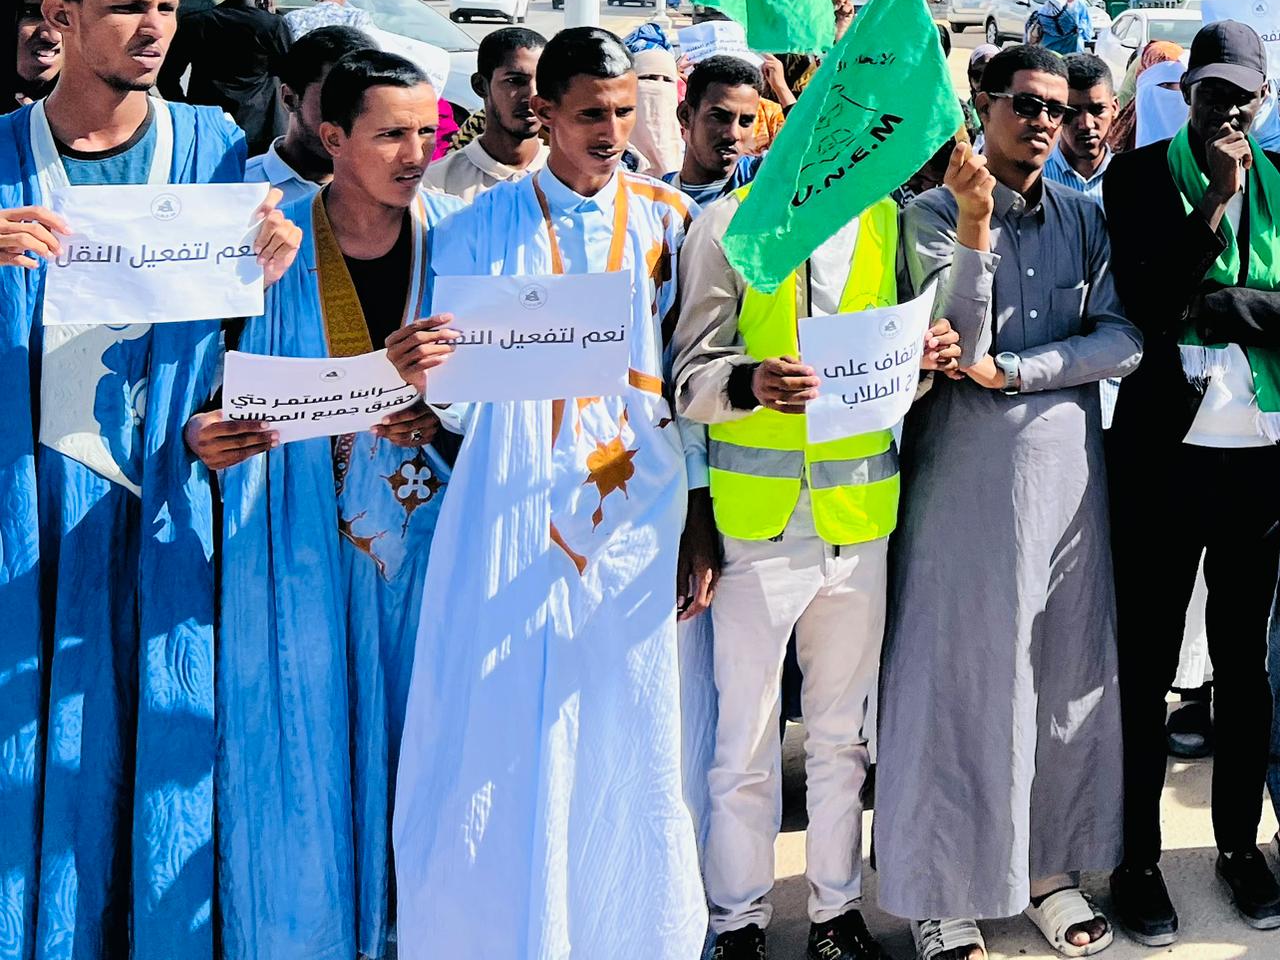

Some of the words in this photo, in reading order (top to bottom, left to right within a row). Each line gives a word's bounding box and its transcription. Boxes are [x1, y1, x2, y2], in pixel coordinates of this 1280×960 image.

[55, 244, 121, 268] النقل
[129, 242, 209, 269] لتفعيل
[216, 242, 259, 264] عم
[435, 329, 493, 345] الن
[500, 327, 575, 350] لتفعيل
[582, 325, 625, 348] نعم
[823, 359, 869, 378] على
[272, 394, 343, 408] مستمر
[350, 383, 410, 400] رابنا
[842, 376, 900, 409] الطلاب
[311, 406, 359, 421] جميع
[365, 393, 419, 414] حقيق
